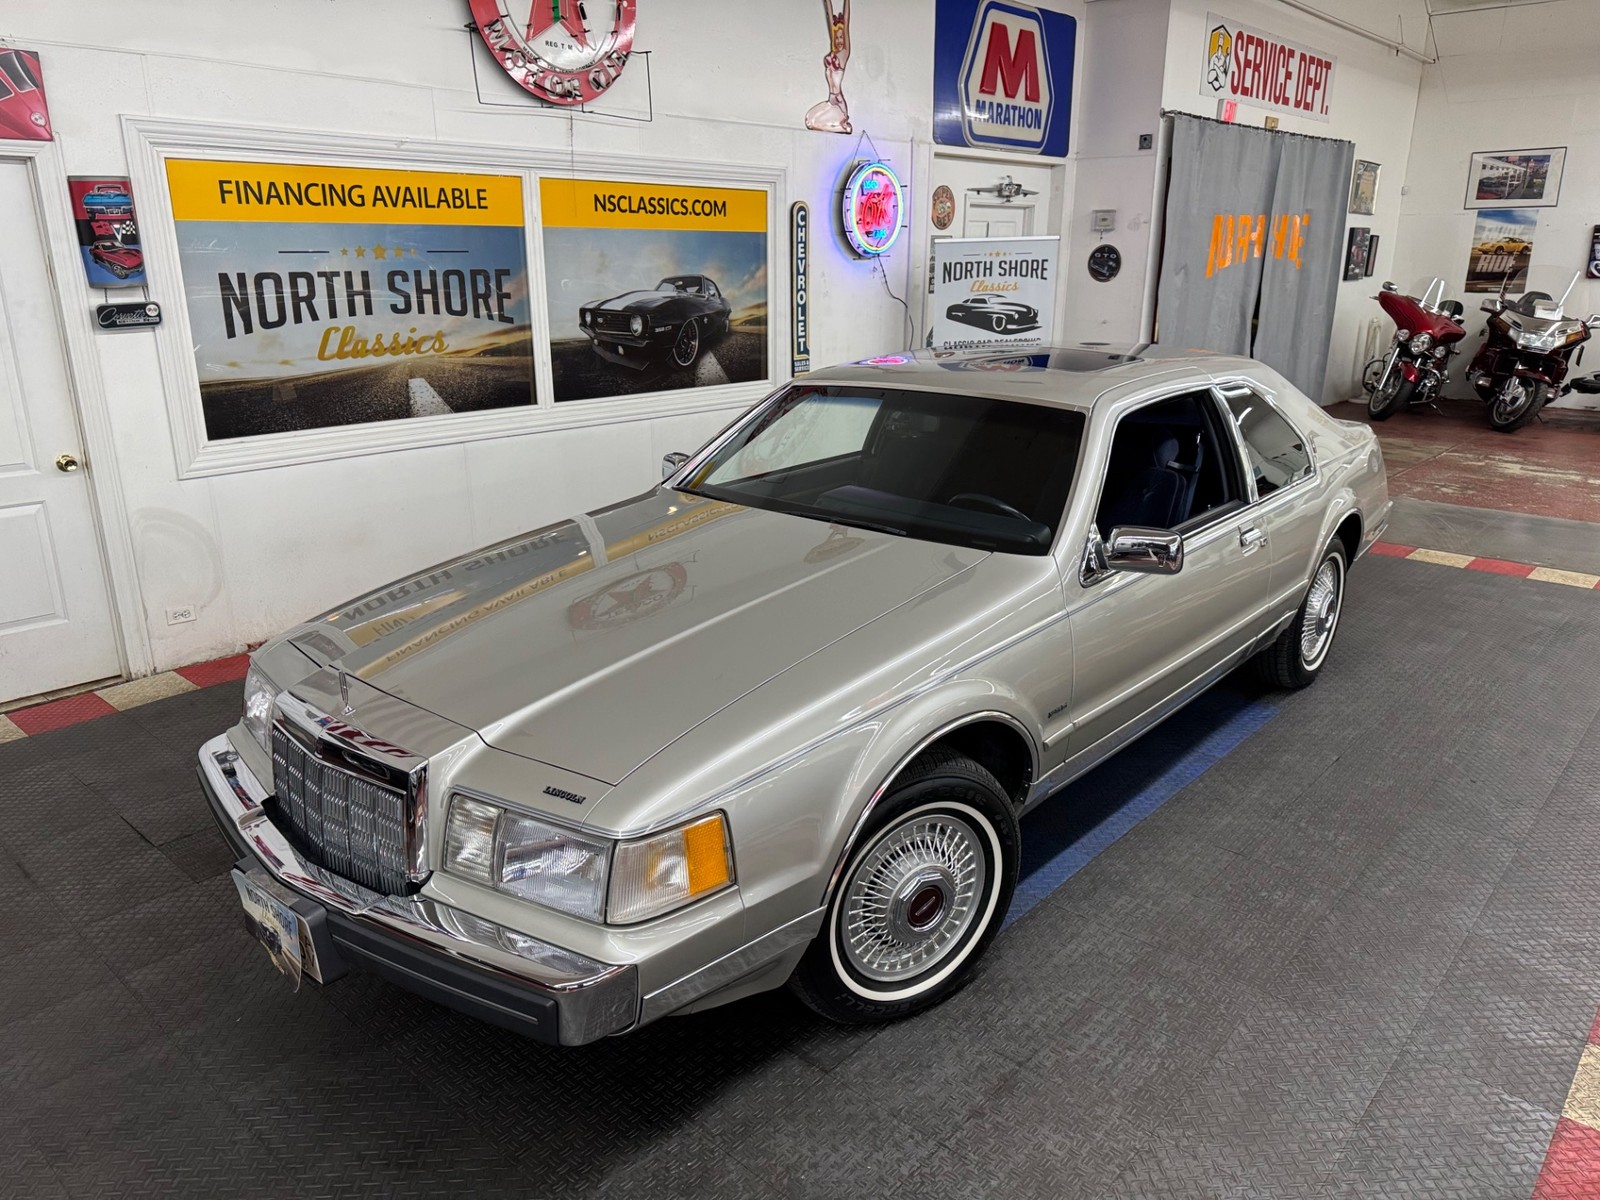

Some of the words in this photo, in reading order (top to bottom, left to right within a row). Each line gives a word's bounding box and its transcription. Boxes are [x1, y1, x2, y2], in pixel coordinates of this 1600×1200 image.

[979, 21, 1041, 103] M
[1230, 30, 1295, 106] SERVICE
[1293, 52, 1332, 115] DEPT.
[975, 99, 1042, 129] MARATHON
[217, 179, 365, 207] FINANCING
[372, 185, 489, 210] AVAILABLE
[593, 193, 727, 217] NSCLASSICS.COM
[797, 211, 806, 352] CHEVROLET
[942, 261, 993, 284] NORTH
[998, 259, 1049, 280] SHORE
[969, 280, 1020, 293] Classics
[218, 270, 374, 340] NORTH
[386, 268, 515, 325] SHORE
[317, 325, 450, 362] Classics
